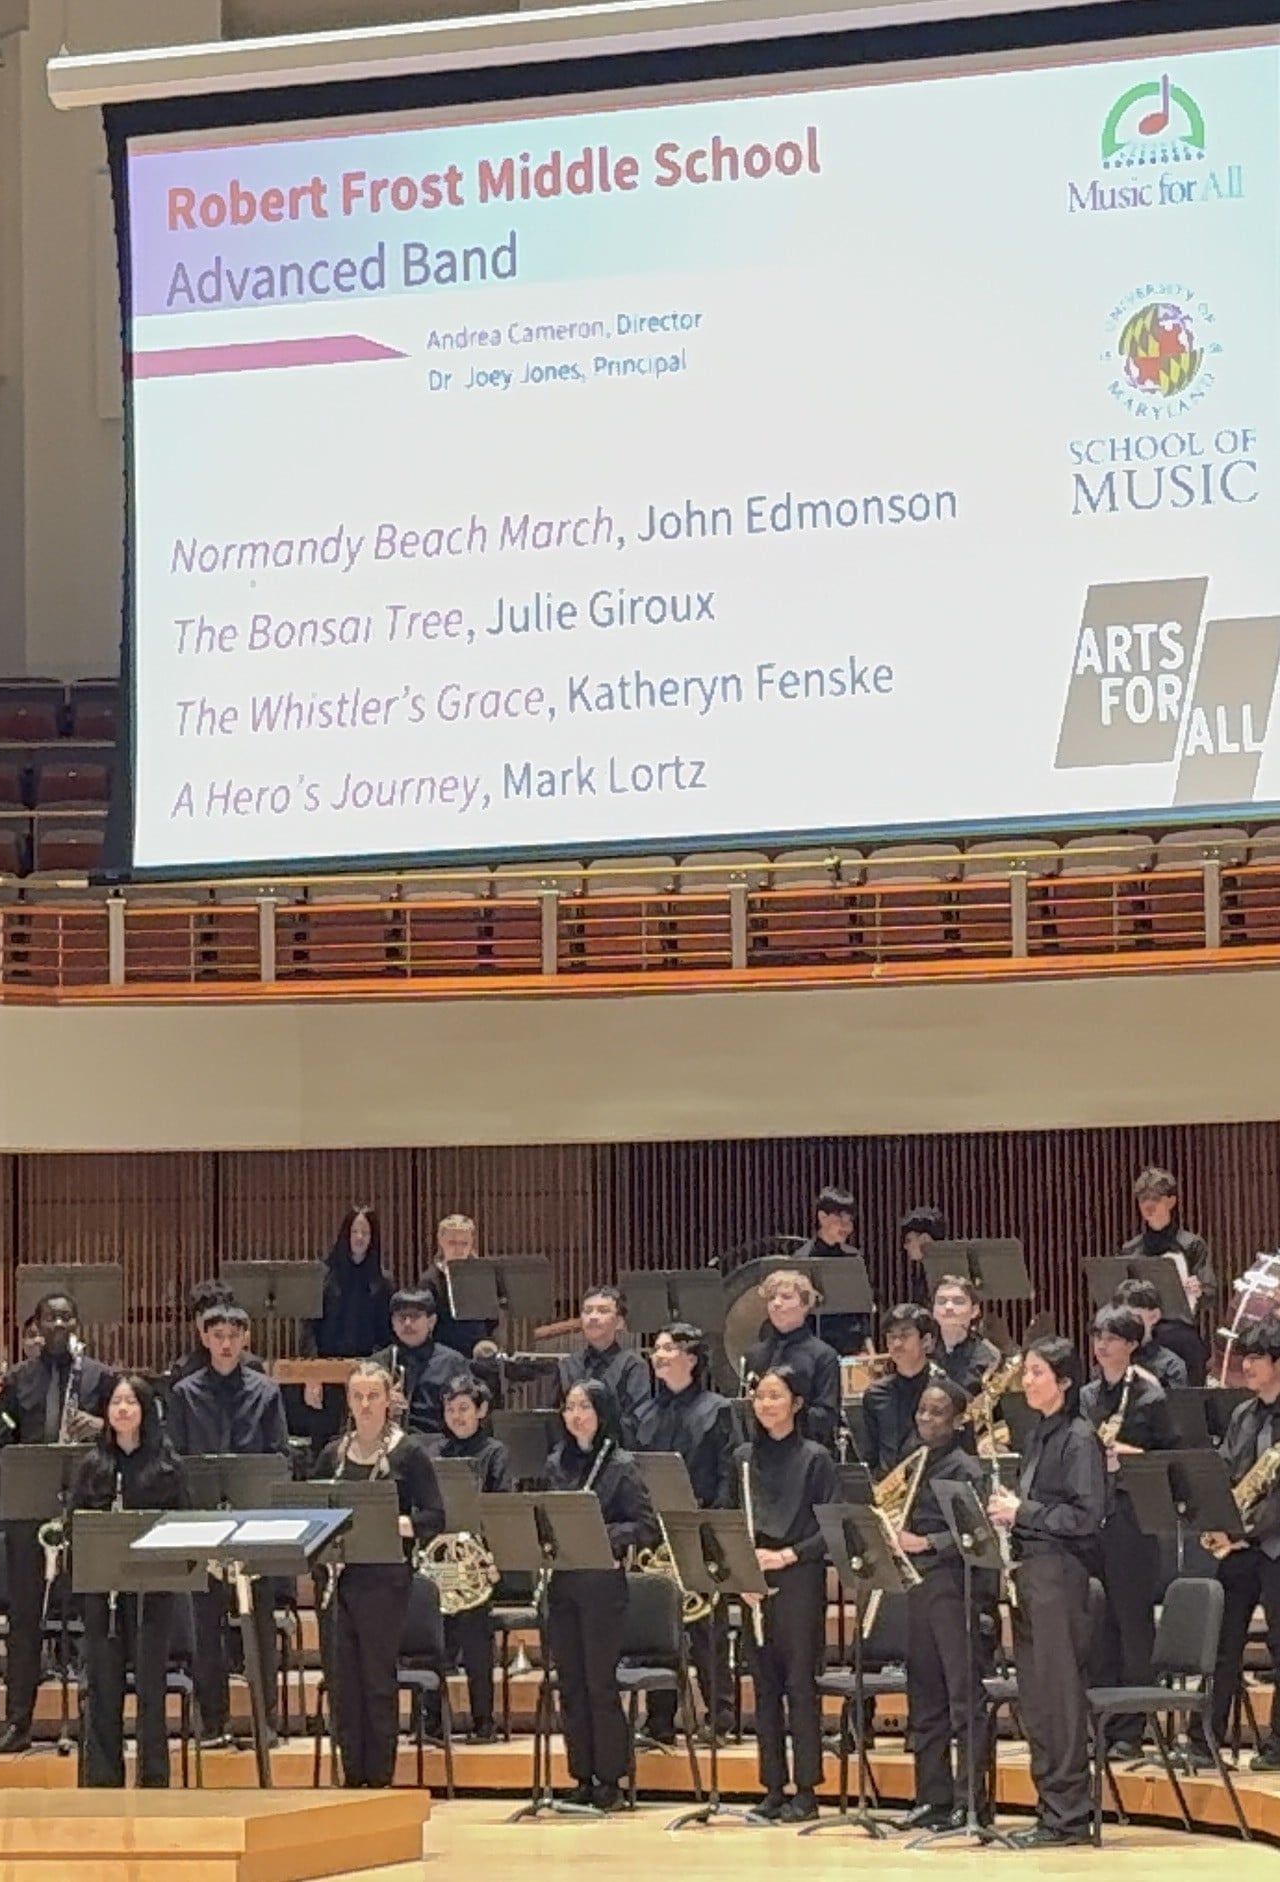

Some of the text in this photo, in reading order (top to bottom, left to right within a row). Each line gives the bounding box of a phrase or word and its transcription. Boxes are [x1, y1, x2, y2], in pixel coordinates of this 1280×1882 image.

[167, 126, 821, 231] Robert Frost Middle School
[1068, 165, 1245, 212] Music for All
[167, 230, 518, 306] Advanced Band
[426, 326, 502, 349] Andrea
[617, 312, 702, 335] Director
[464, 367, 512, 390] Joey
[520, 362, 586, 383] Jones,
[593, 348, 686, 379] Principal
[1069, 429, 1257, 464] SCHOOL OF
[1071, 460, 1259, 515] MUSIC
[170, 487, 958, 575] Normandy Beach March, John Edmonson
[175, 587, 716, 654] The Bonsai Tree, Julie Giroux
[1075, 621, 1185, 674] ARTS
[176, 656, 894, 736] The Whistler's Grace, Katheryn Fenske
[1101, 674, 1183, 725] FOR
[1185, 704, 1265, 756] ALL
[170, 753, 707, 818] A Hero's Journey, Mark Lortz
